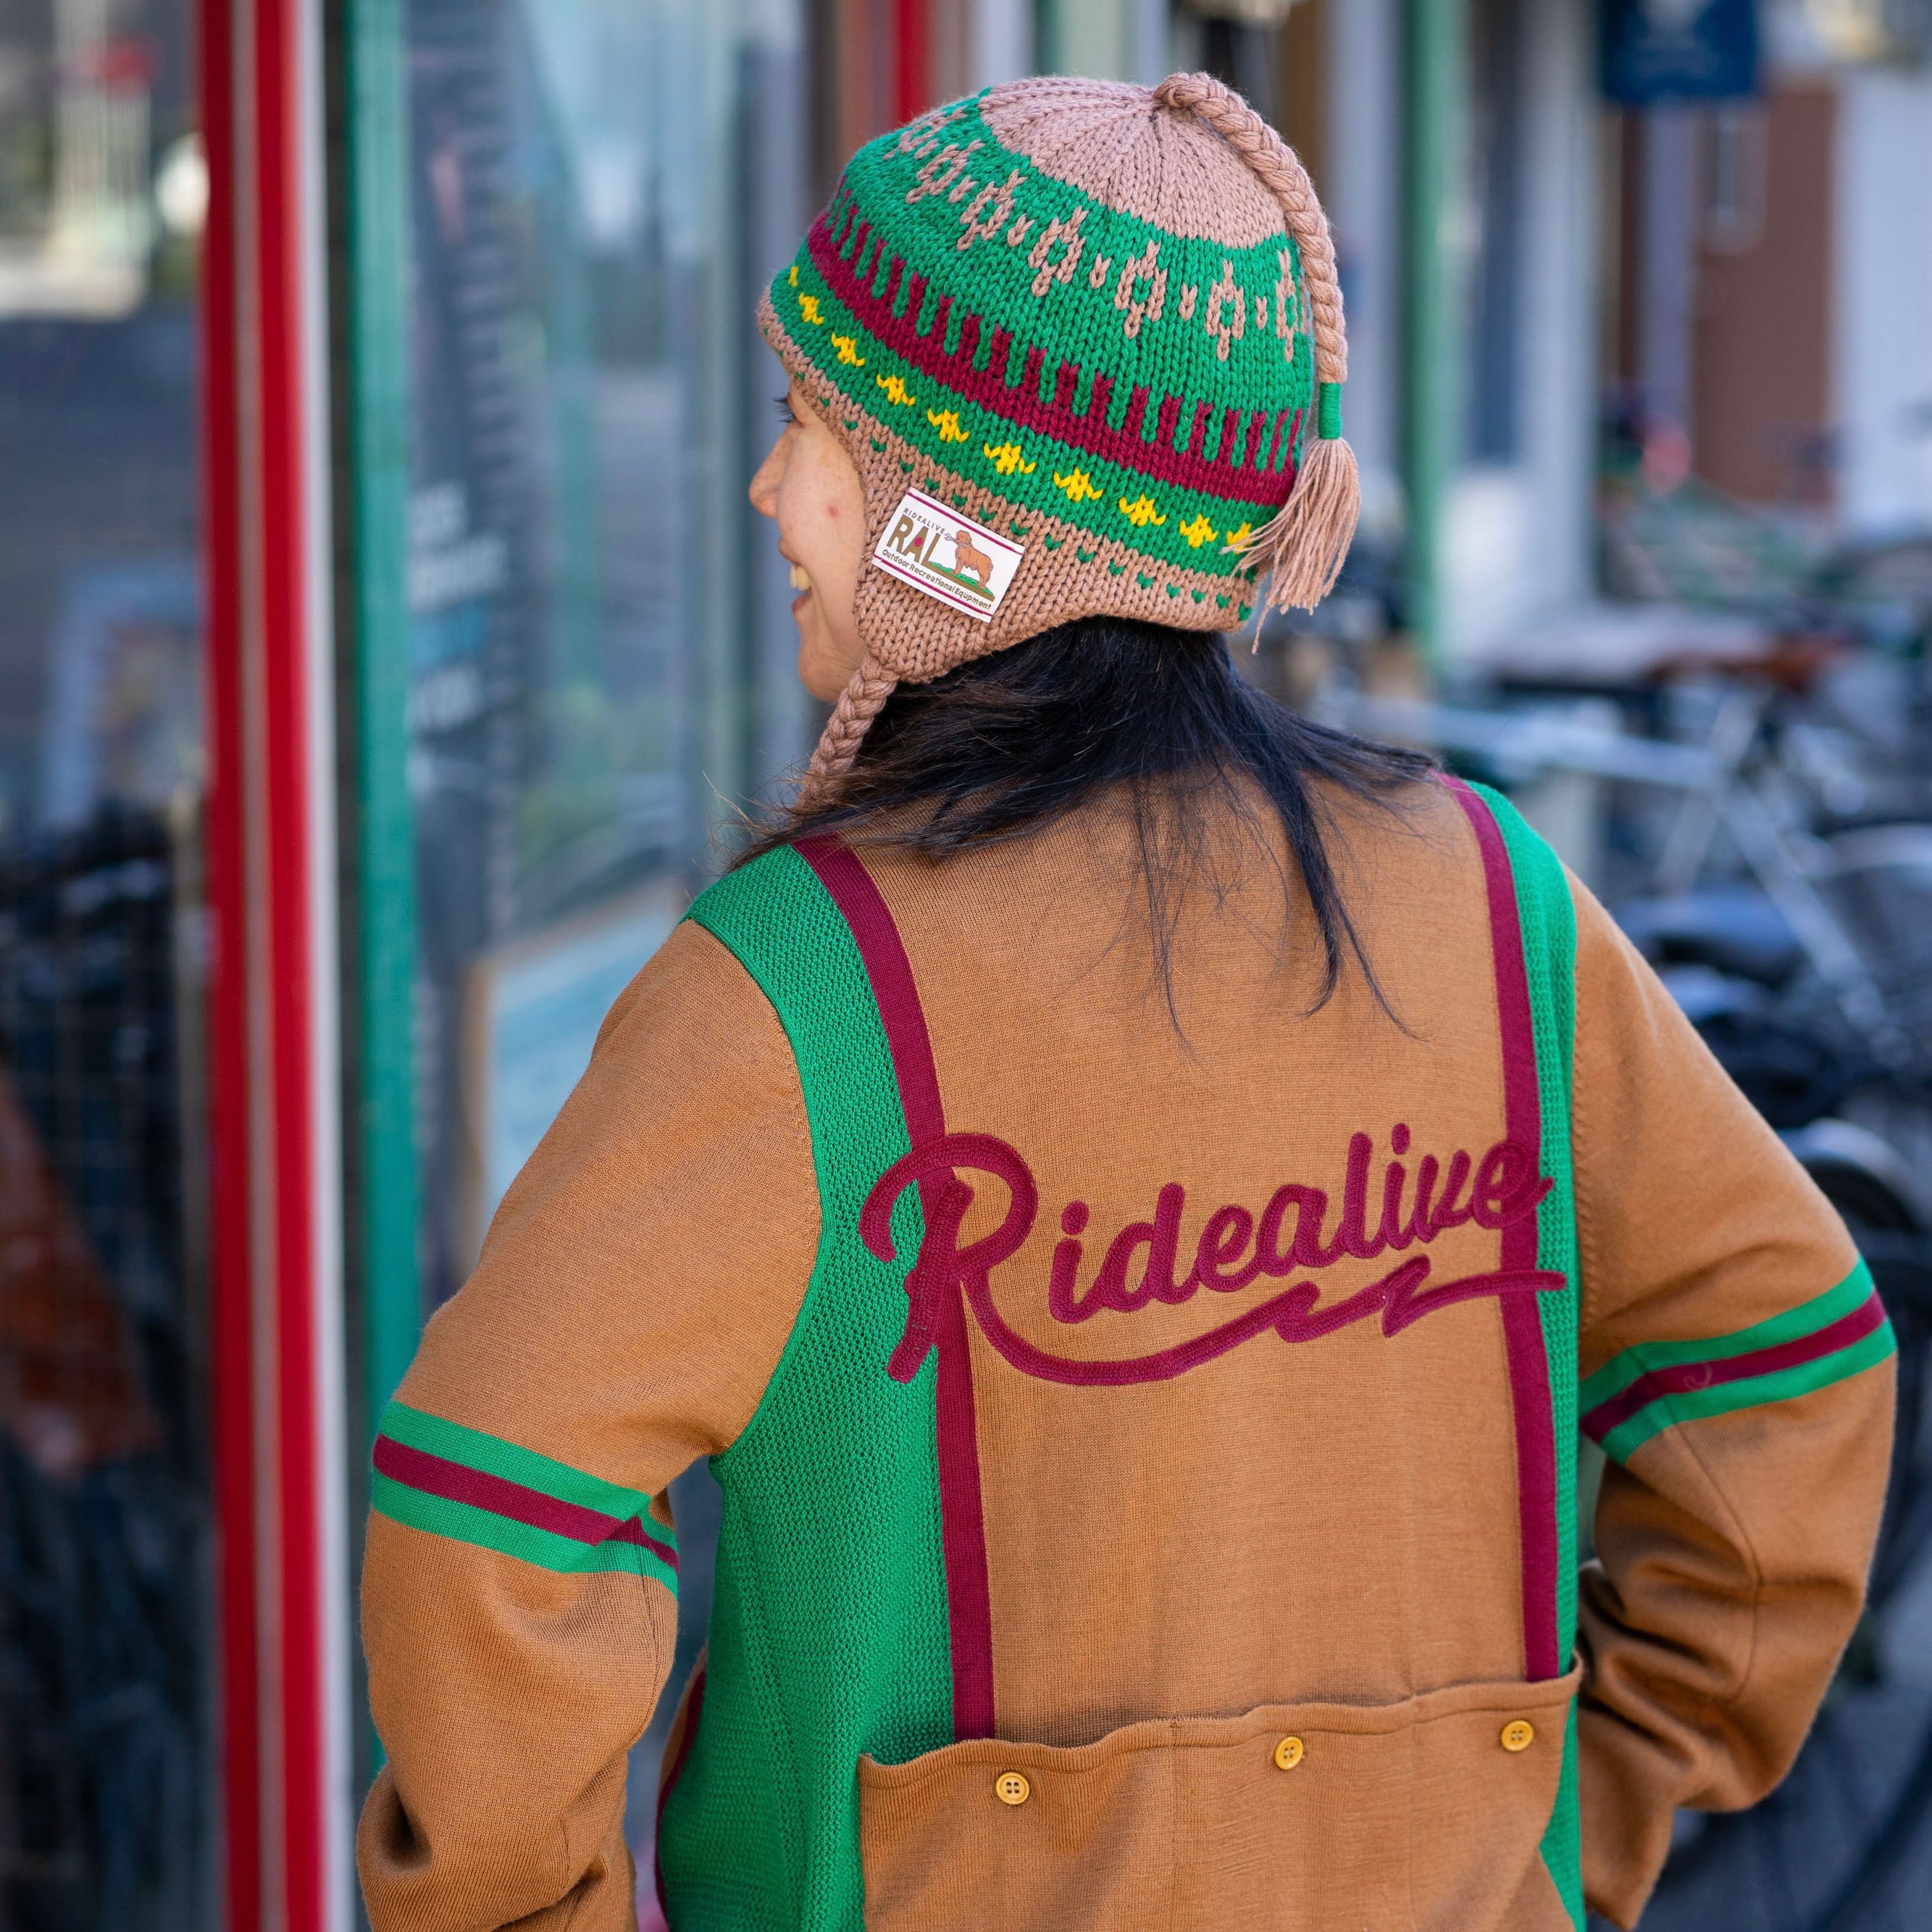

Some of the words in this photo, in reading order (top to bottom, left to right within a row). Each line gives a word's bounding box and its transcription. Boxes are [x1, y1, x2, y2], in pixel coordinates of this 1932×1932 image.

[886, 514, 941, 566] RAL
[904, 508, 945, 534] RIDEALIVE
[882, 549, 909, 568] Outdoor
[909, 564, 956, 592] Recreational
[858, 1124, 1553, 1385] Ridealive
